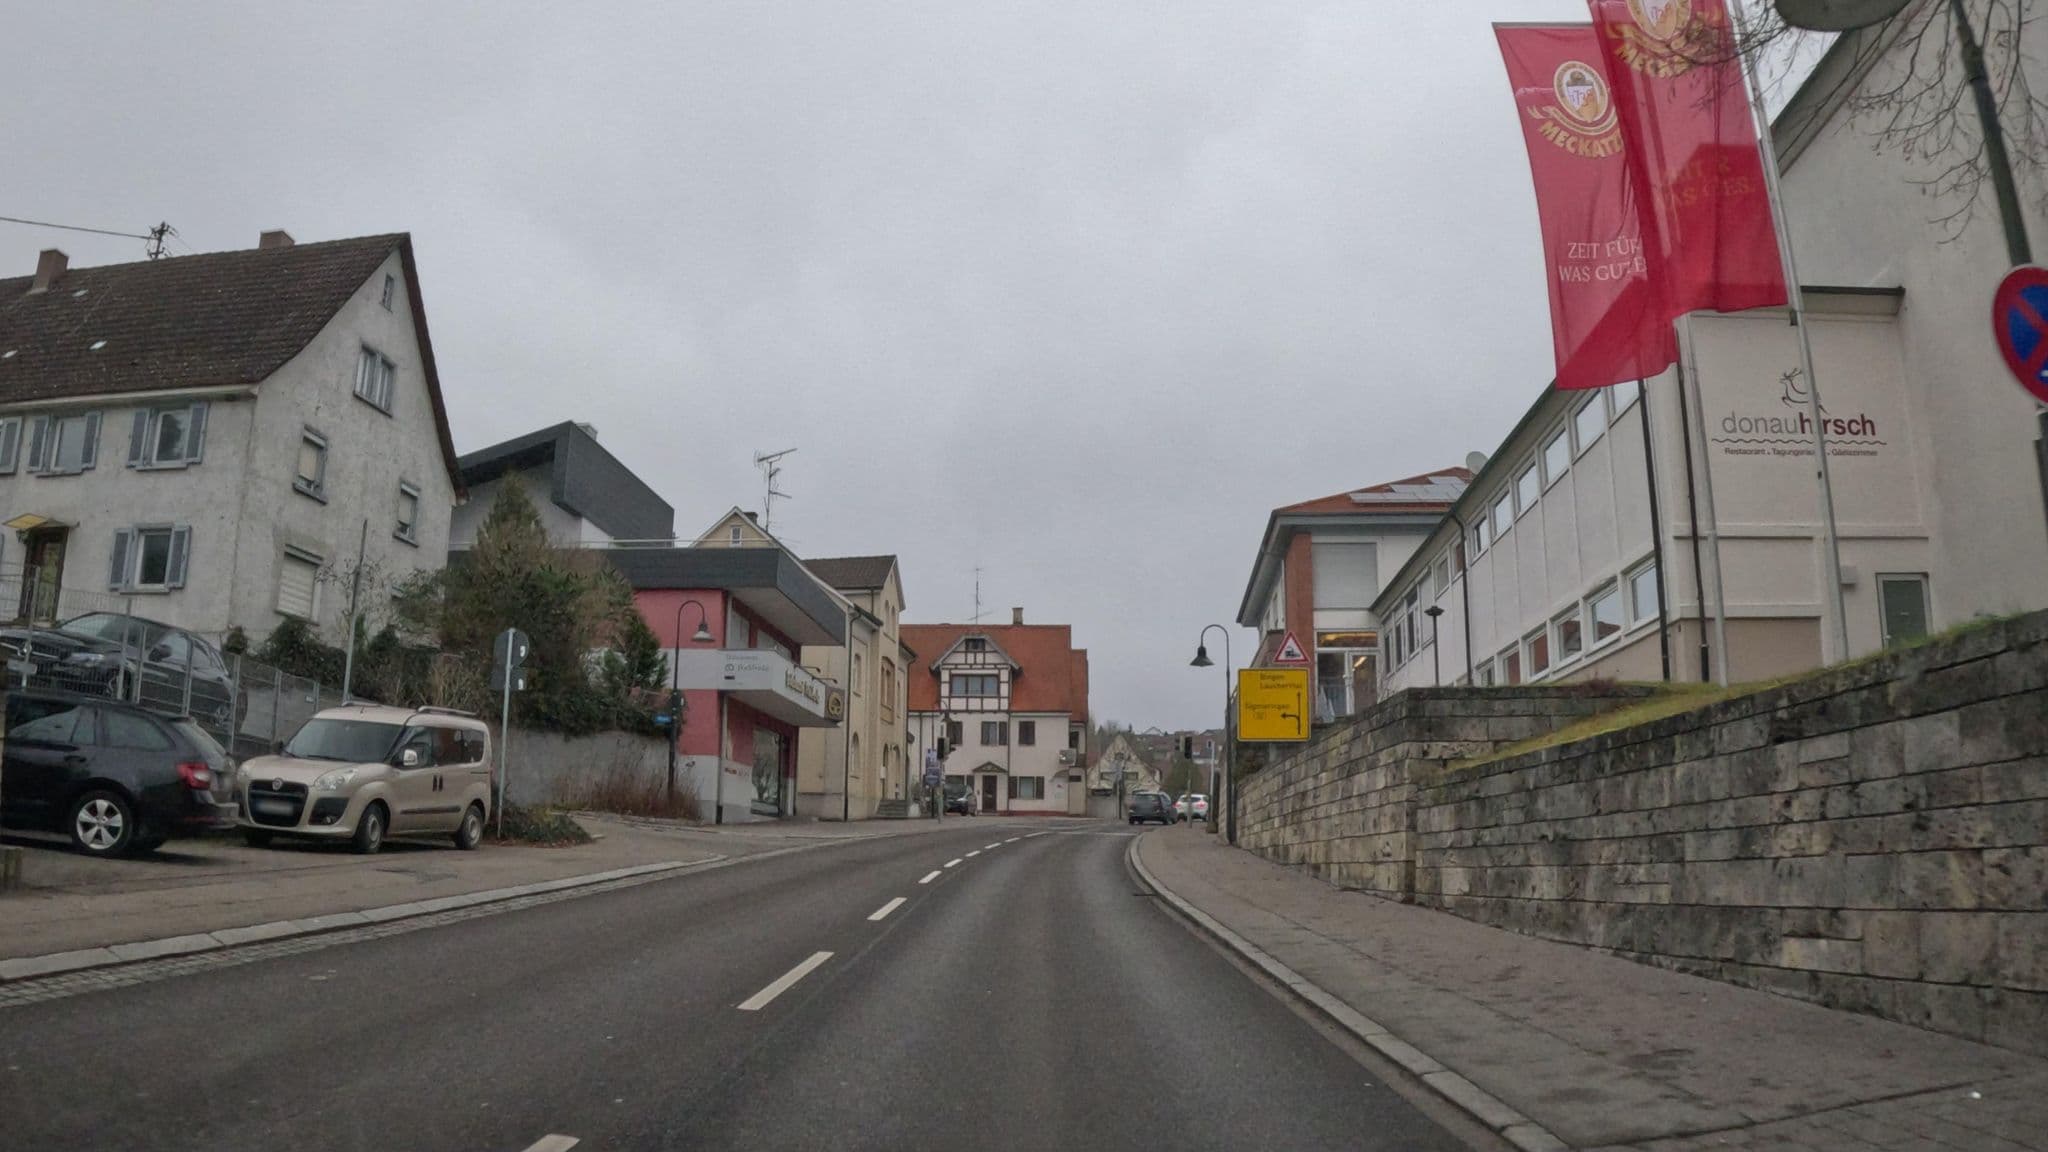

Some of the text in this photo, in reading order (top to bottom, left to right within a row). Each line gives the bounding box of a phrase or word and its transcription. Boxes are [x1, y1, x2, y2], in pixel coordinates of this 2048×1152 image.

[1567, 242, 1600, 260] ZEIT
[1558, 264, 1592, 282] WAS
[1722, 410, 1876, 436] donauhrsch
